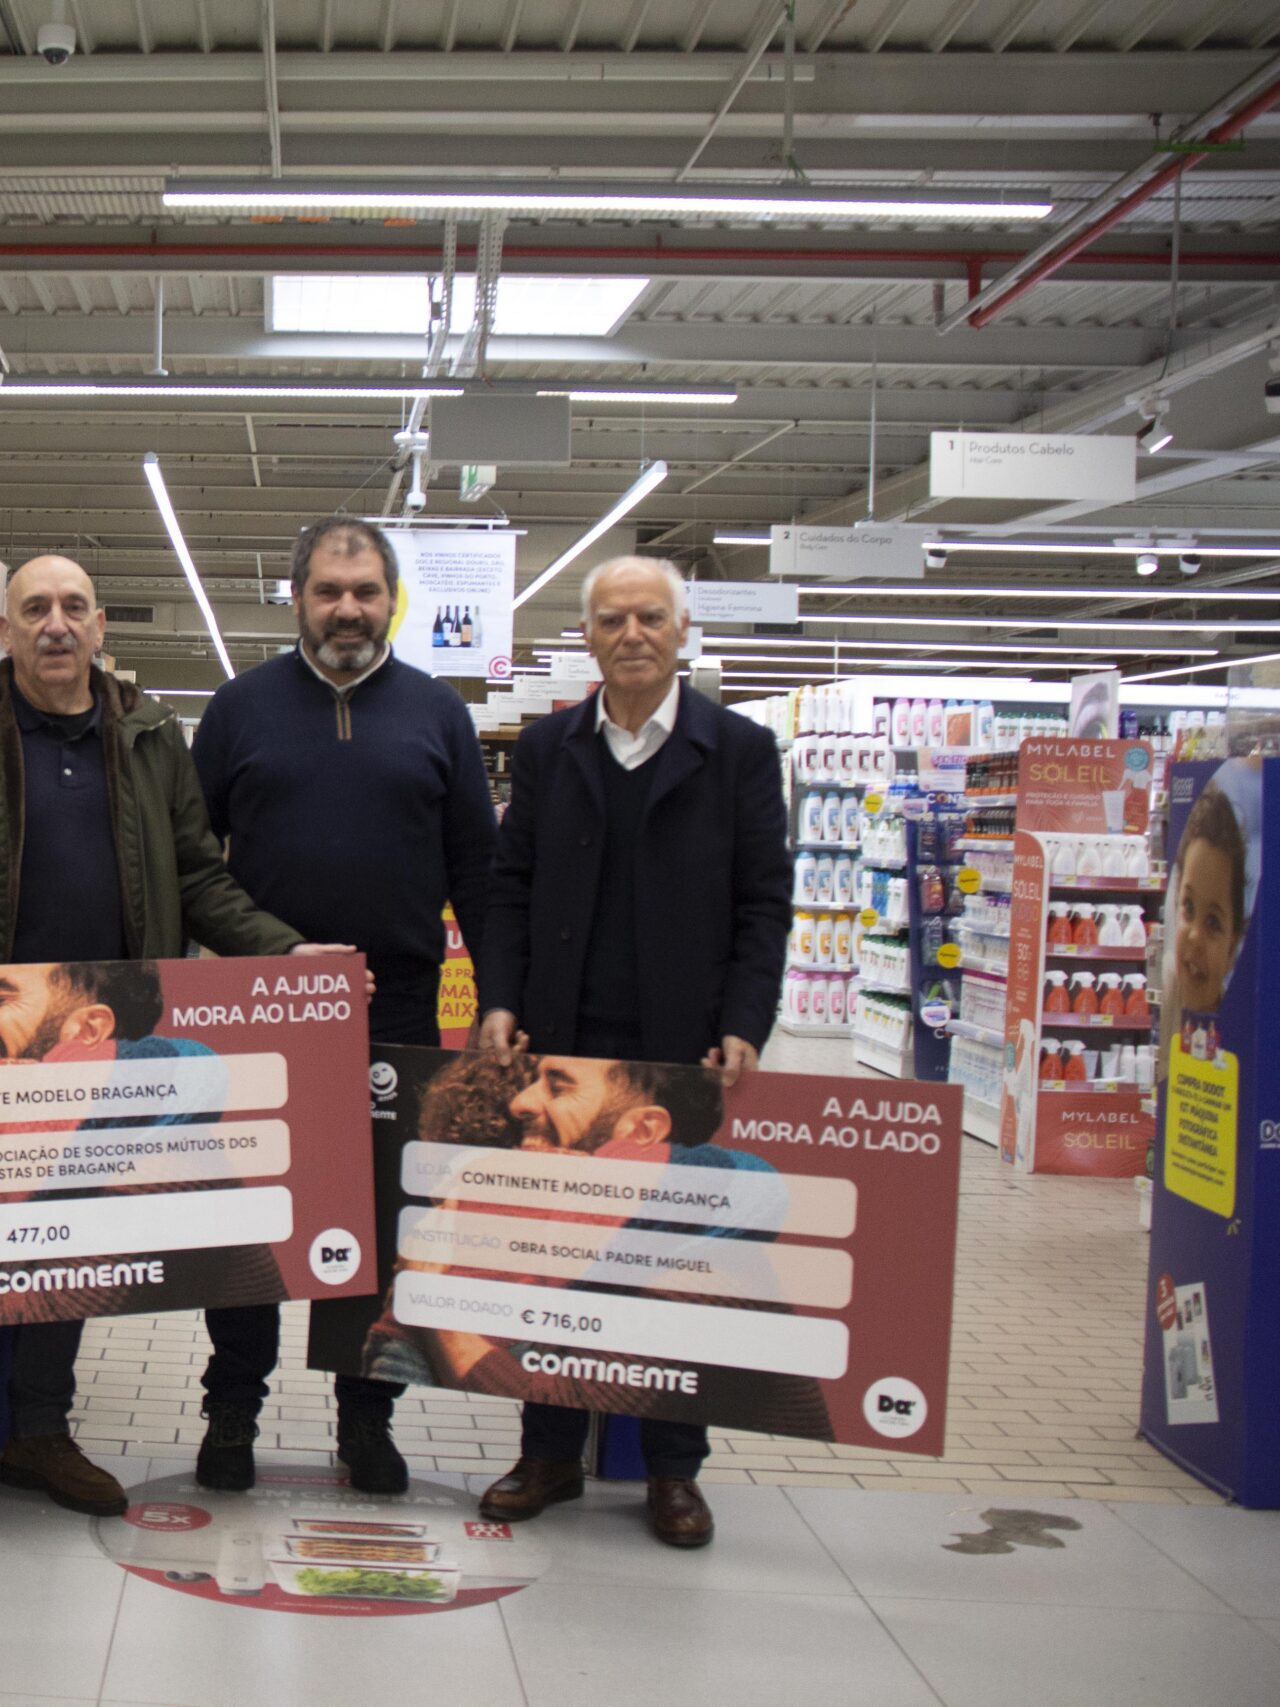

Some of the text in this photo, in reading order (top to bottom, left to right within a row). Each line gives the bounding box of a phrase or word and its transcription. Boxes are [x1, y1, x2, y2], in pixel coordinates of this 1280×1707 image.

[949, 440, 954, 450] 1
[969, 441, 1074, 455] Produtos Cabelo
[784, 531, 790, 540] 2
[800, 532, 893, 546] Cuidados do Corpo
[1026, 744, 1116, 758] MYLABEL
[1029, 762, 1112, 783] SOLEIL
[1014, 854, 1043, 868] MYLABEL
[251, 974, 350, 996] A AJUDA
[172, 1001, 351, 1027] MORA AO LADO
[15, 1088, 86, 1105] MODELO
[91, 1084, 178, 1102] BRAGANÇA
[823, 1097, 942, 1126] A AJUDA
[1063, 1111, 1140, 1124] MYLABEL
[732, 1118, 941, 1155] MORA AO LADO
[1063, 1132, 1136, 1150] SOLEIL
[63, 1146, 81, 1159] DE
[85, 1142, 163, 1158] SOCORROS
[167, 1137, 226, 1153] MÚTUOS
[229, 1136, 257, 1149] DOS
[36, 1166, 55, 1178] DE
[59, 1161, 135, 1178] BRAGANÇA
[417, 1162, 731, 1210] LOJA CONTINENTE MODELO BRAGANÇA
[7, 1225, 71, 1246] 477,00
[412, 1227, 501, 1250] INSTITUIÇÃO
[509, 1240, 713, 1274] OBRA SOCIAL PADRE MIGUEL
[409, 1292, 603, 1333] VALOR DOADO € 716,00
[521, 1351, 698, 1394] CONTINENTE
[142, 1511, 192, 1524] 5x
